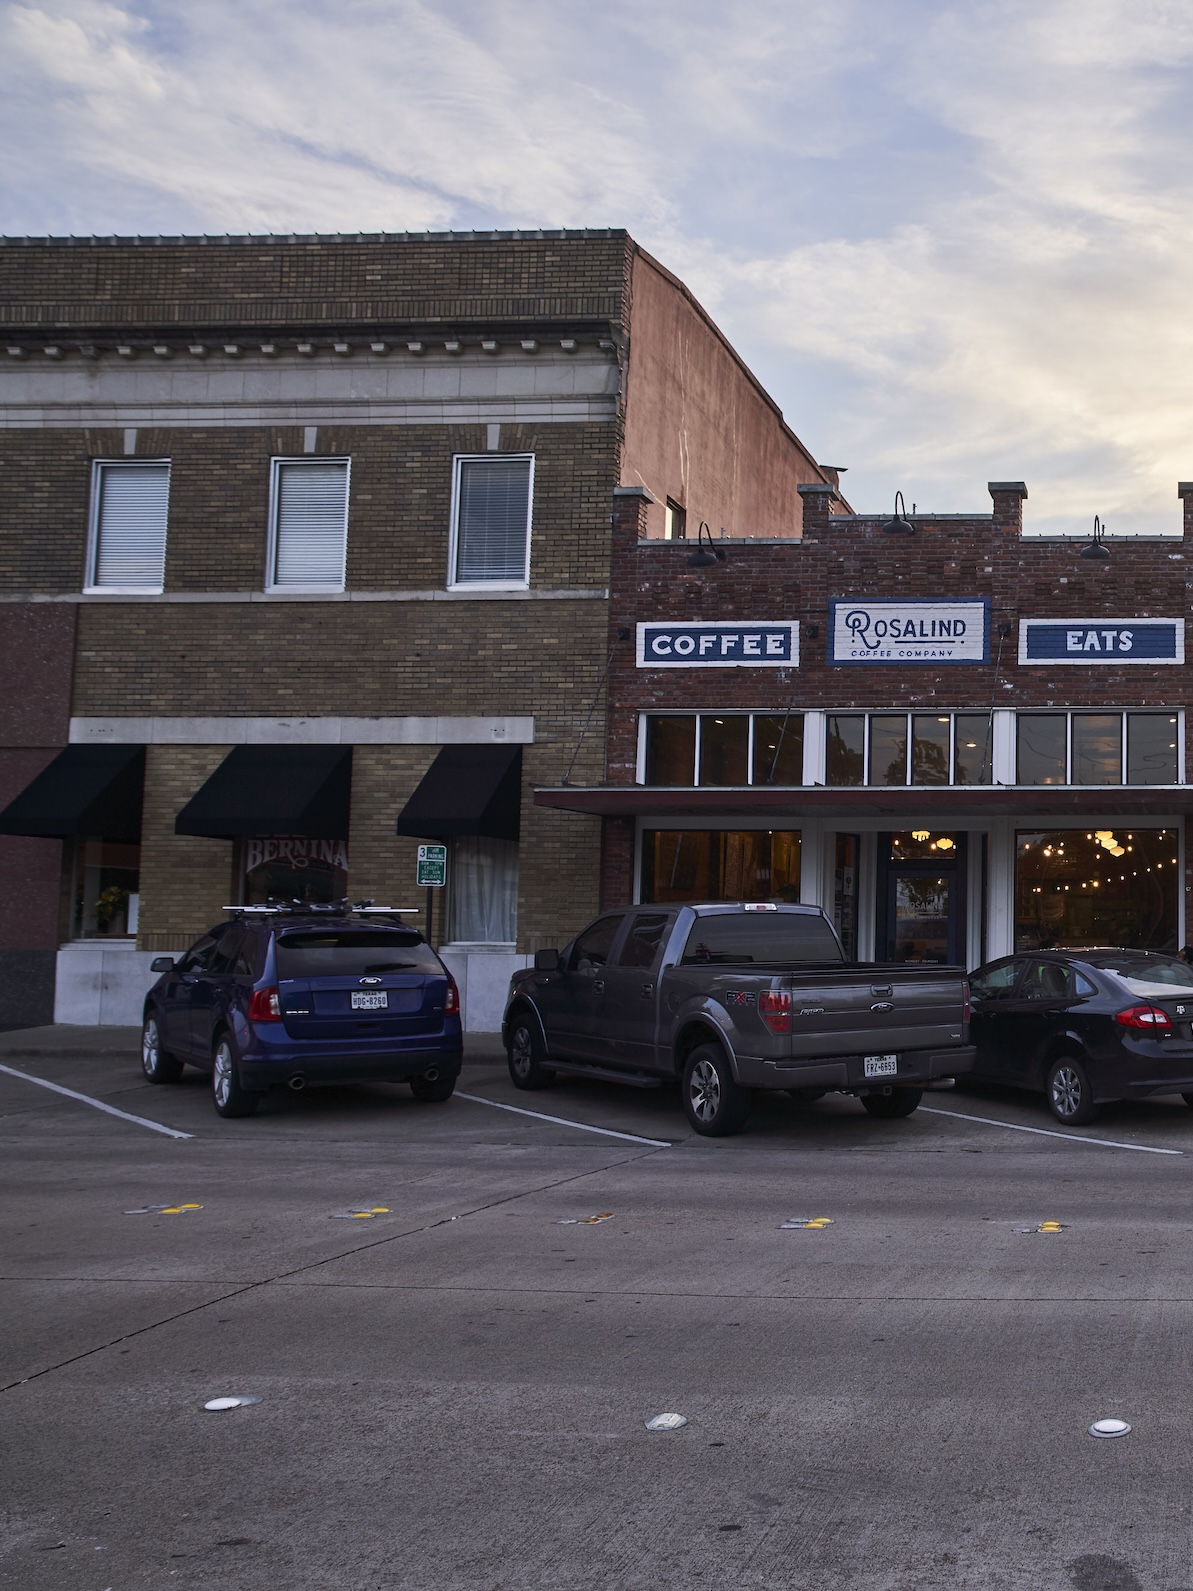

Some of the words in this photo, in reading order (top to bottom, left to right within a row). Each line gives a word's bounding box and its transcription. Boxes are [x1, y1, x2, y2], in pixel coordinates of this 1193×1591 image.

[845, 610, 967, 649] ROSALIND
[1066, 630, 1134, 652] EATS
[650, 633, 786, 656] COFFEE
[246, 839, 349, 873] BERNINA
[419, 847, 426, 857] 3
